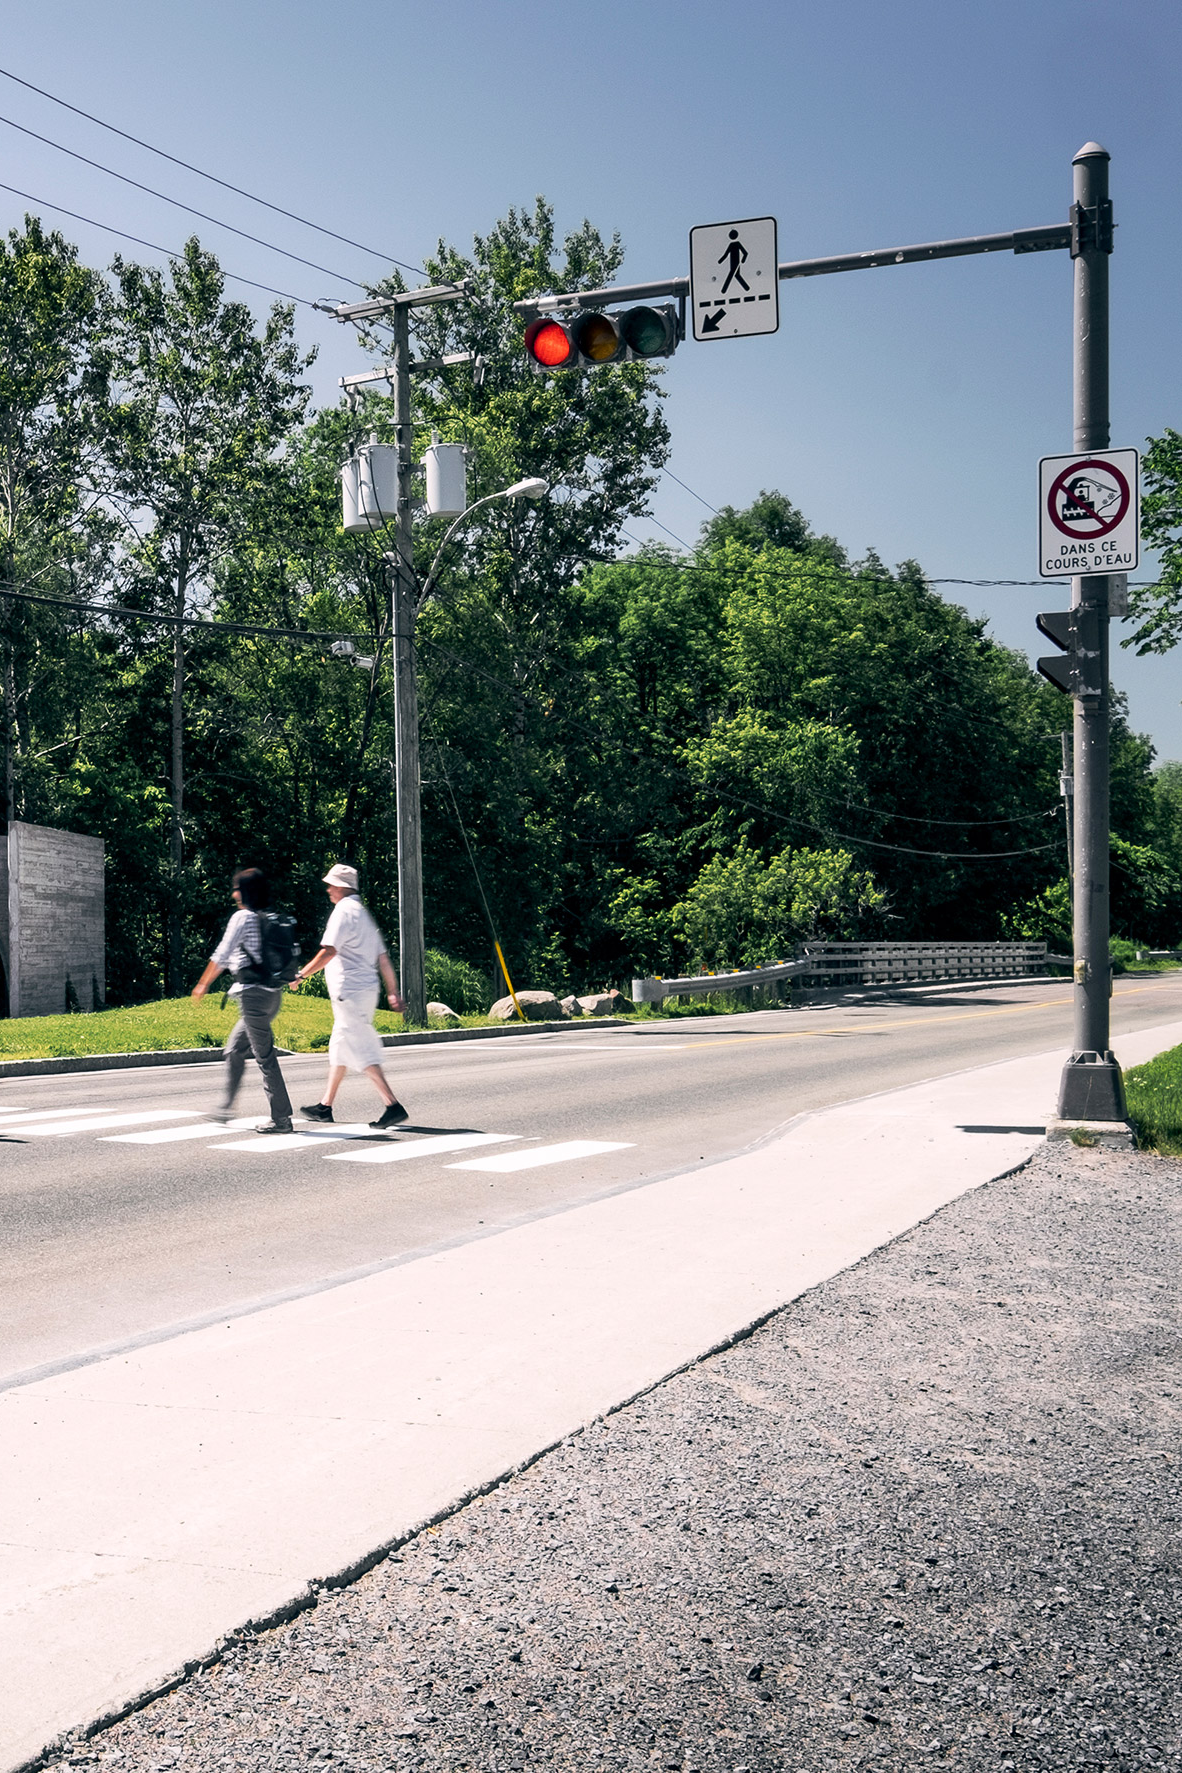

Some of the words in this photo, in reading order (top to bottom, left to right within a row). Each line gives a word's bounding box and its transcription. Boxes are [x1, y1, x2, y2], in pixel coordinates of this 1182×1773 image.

[1060, 543, 1095, 555] DANS
[1101, 541, 1117, 552] CE
[1046, 557, 1088, 570] COURS
[1094, 553, 1131, 565] D'EAU
